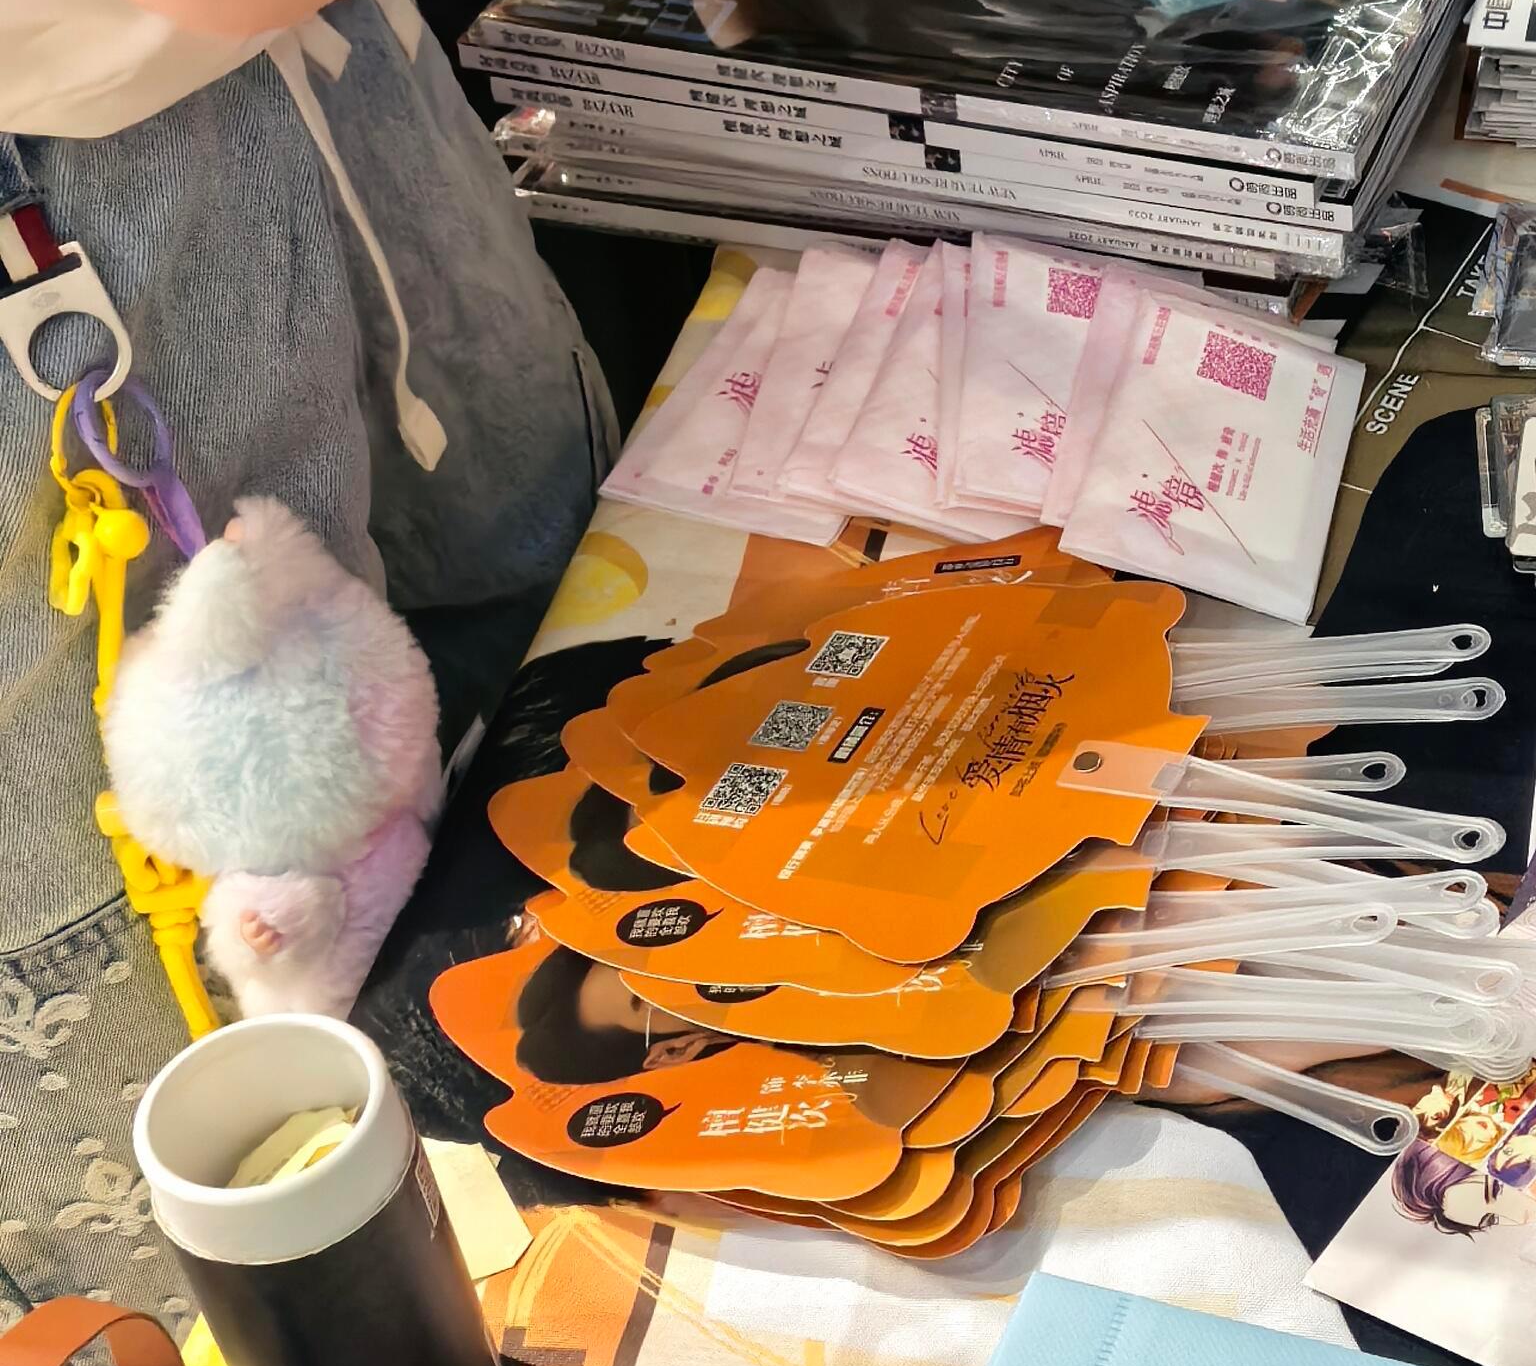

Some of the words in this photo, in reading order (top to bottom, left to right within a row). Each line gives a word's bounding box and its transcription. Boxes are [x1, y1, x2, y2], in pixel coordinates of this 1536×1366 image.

[996, 58, 1024, 89] CITY
[1056, 64, 1074, 83] OF
[1366, 374, 1421, 435] SCENE
[960, 669, 1076, 793] 爱情有烟火
